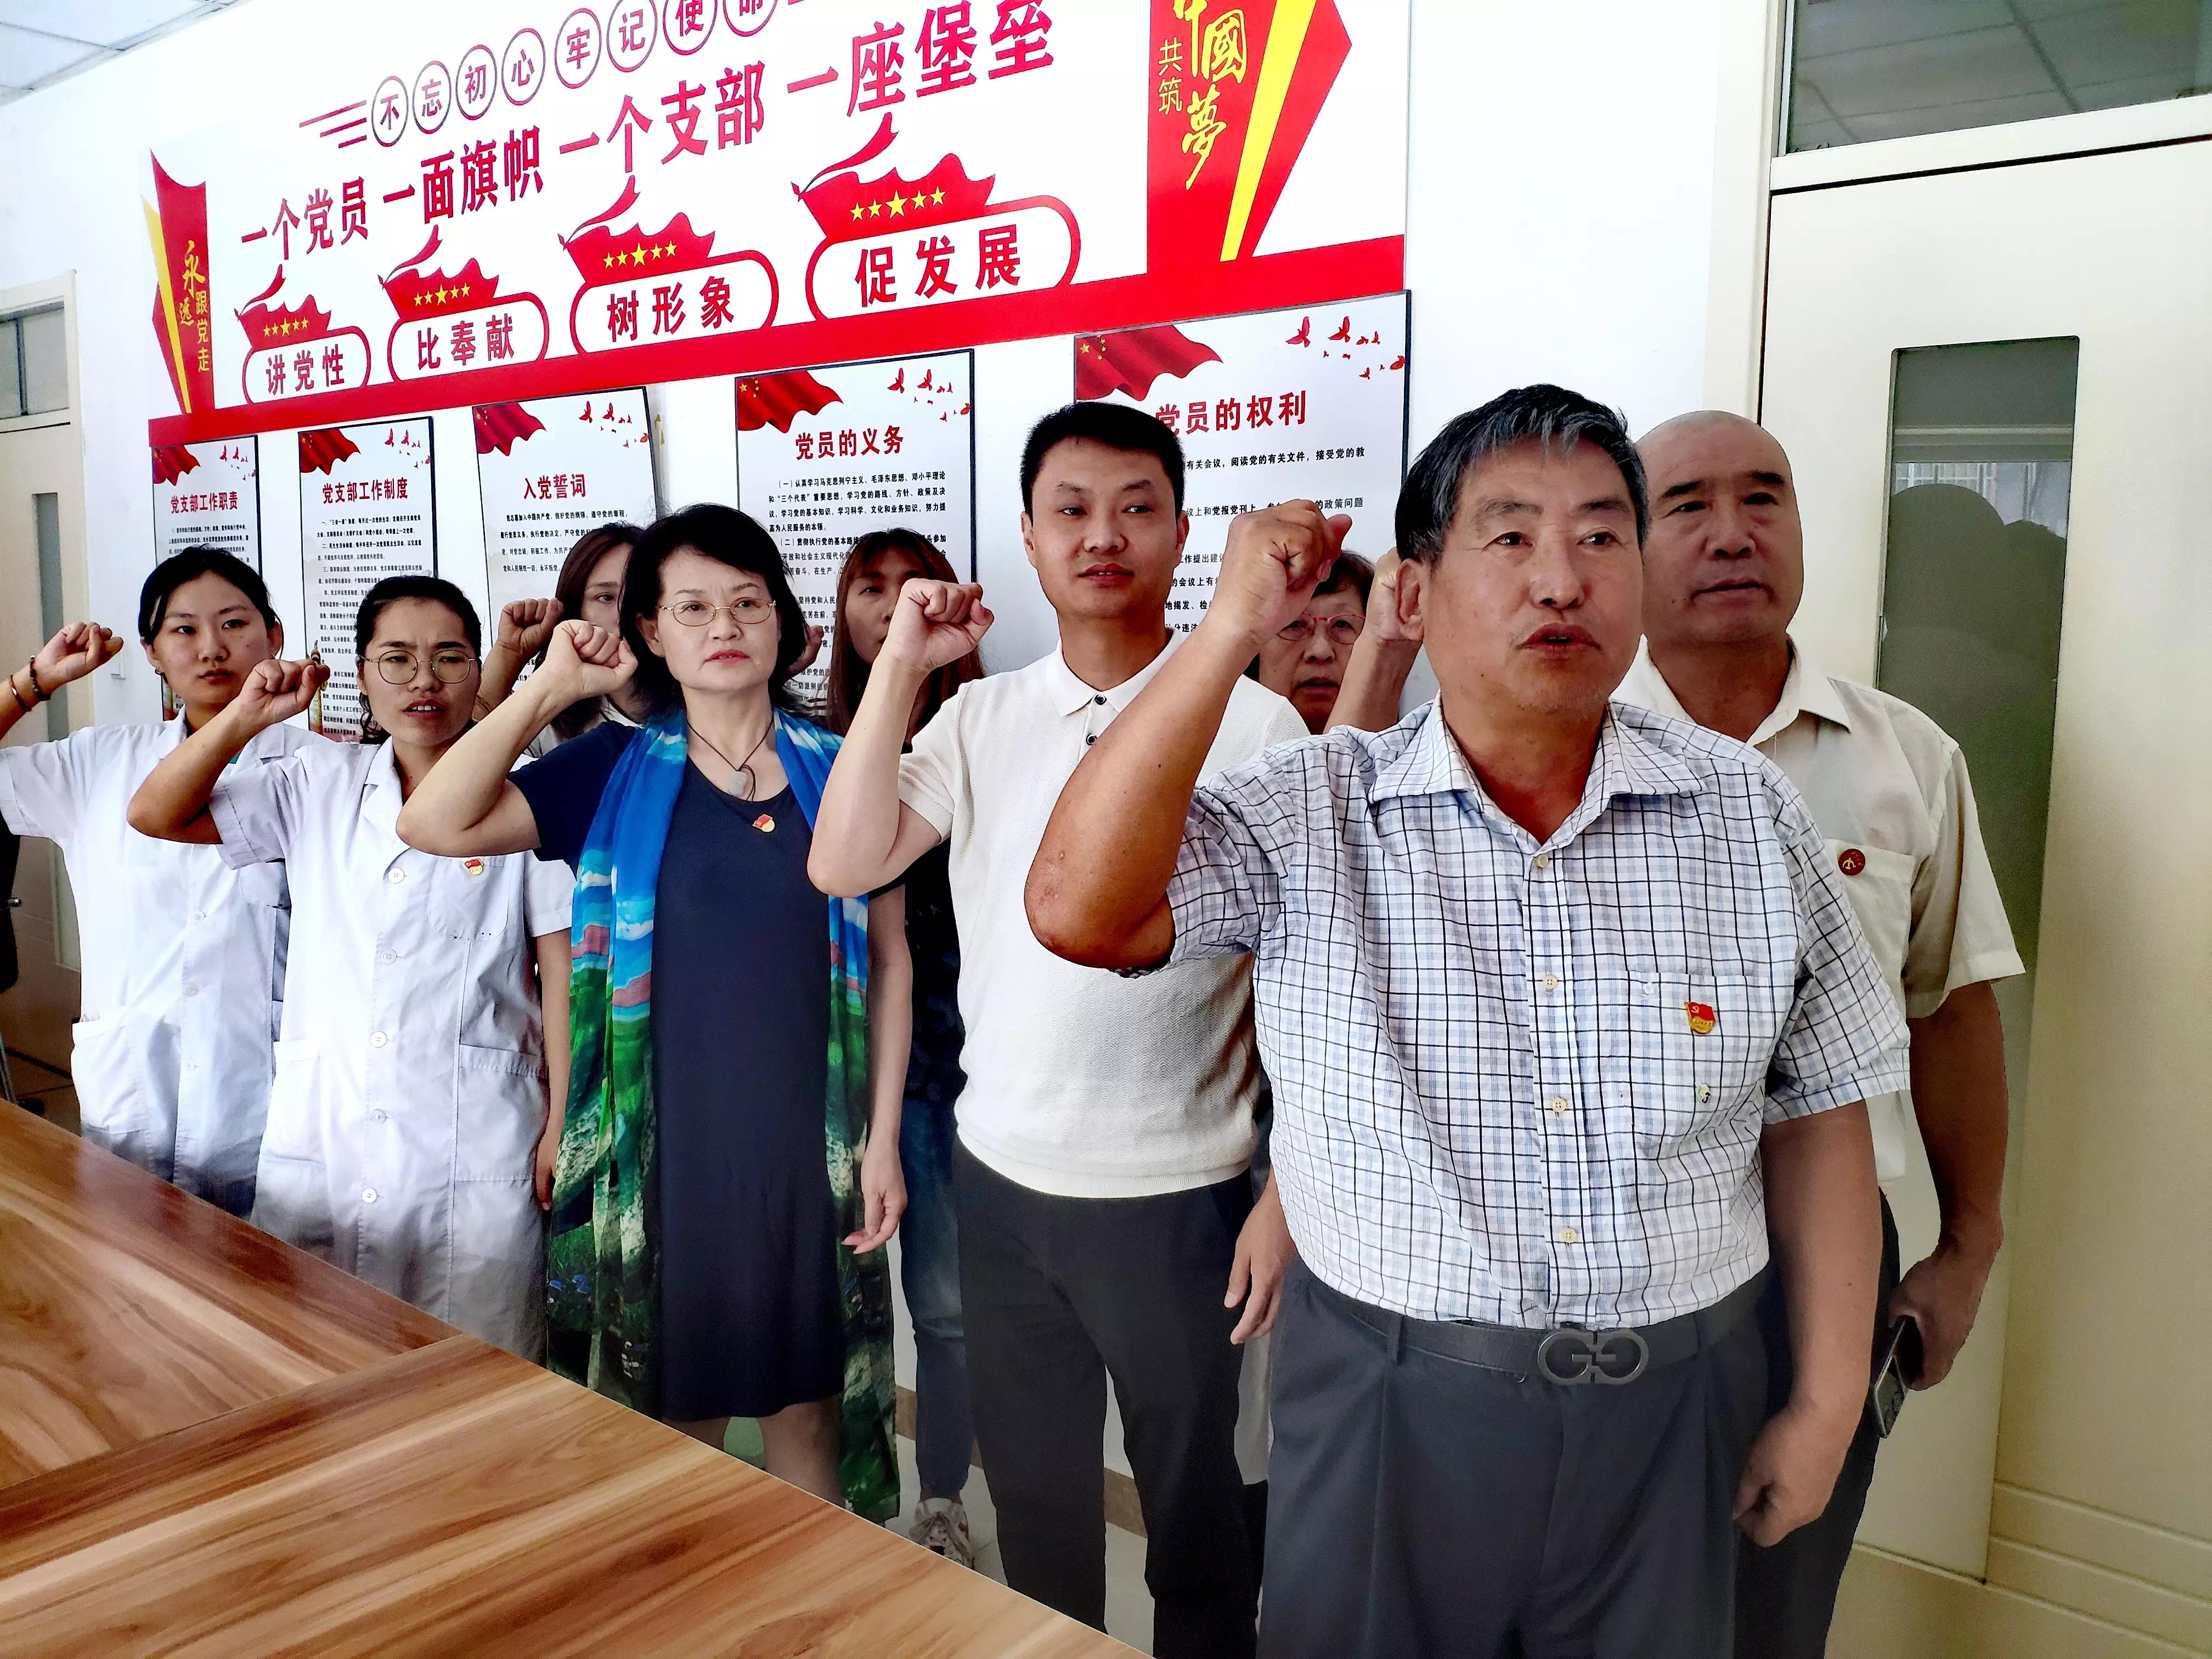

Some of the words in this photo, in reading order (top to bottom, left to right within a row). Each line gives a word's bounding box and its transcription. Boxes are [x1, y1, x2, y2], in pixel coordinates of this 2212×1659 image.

[1158, 36, 1183, 115] 共筑
[241, 177, 368, 261] 一个党员
[383, 125, 544, 224] 一面旗帜
[559, 60, 766, 174] 一个支部
[787, 0, 1055, 117] 一座堡垒
[854, 223, 1022, 308] 促发展
[196, 290, 211, 373] 跟党走
[607, 276, 735, 342] 树形象
[417, 313, 515, 370] 比奉献
[265, 344, 345, 395] 讲党性
[1155, 390, 1307, 436] 党员的权利
[795, 425, 904, 460] 党员的义务
[171, 490, 238, 514] 党支部工作职责
[323, 477, 408, 504] 党支部工作制度
[523, 473, 586, 500] 入党誓词
[780, 552, 851, 561] 开放和社会主义现代化
[1165, 600, 1212, 610] 地揭发、检
[1172, 576, 1218, 588] 的会议上有
